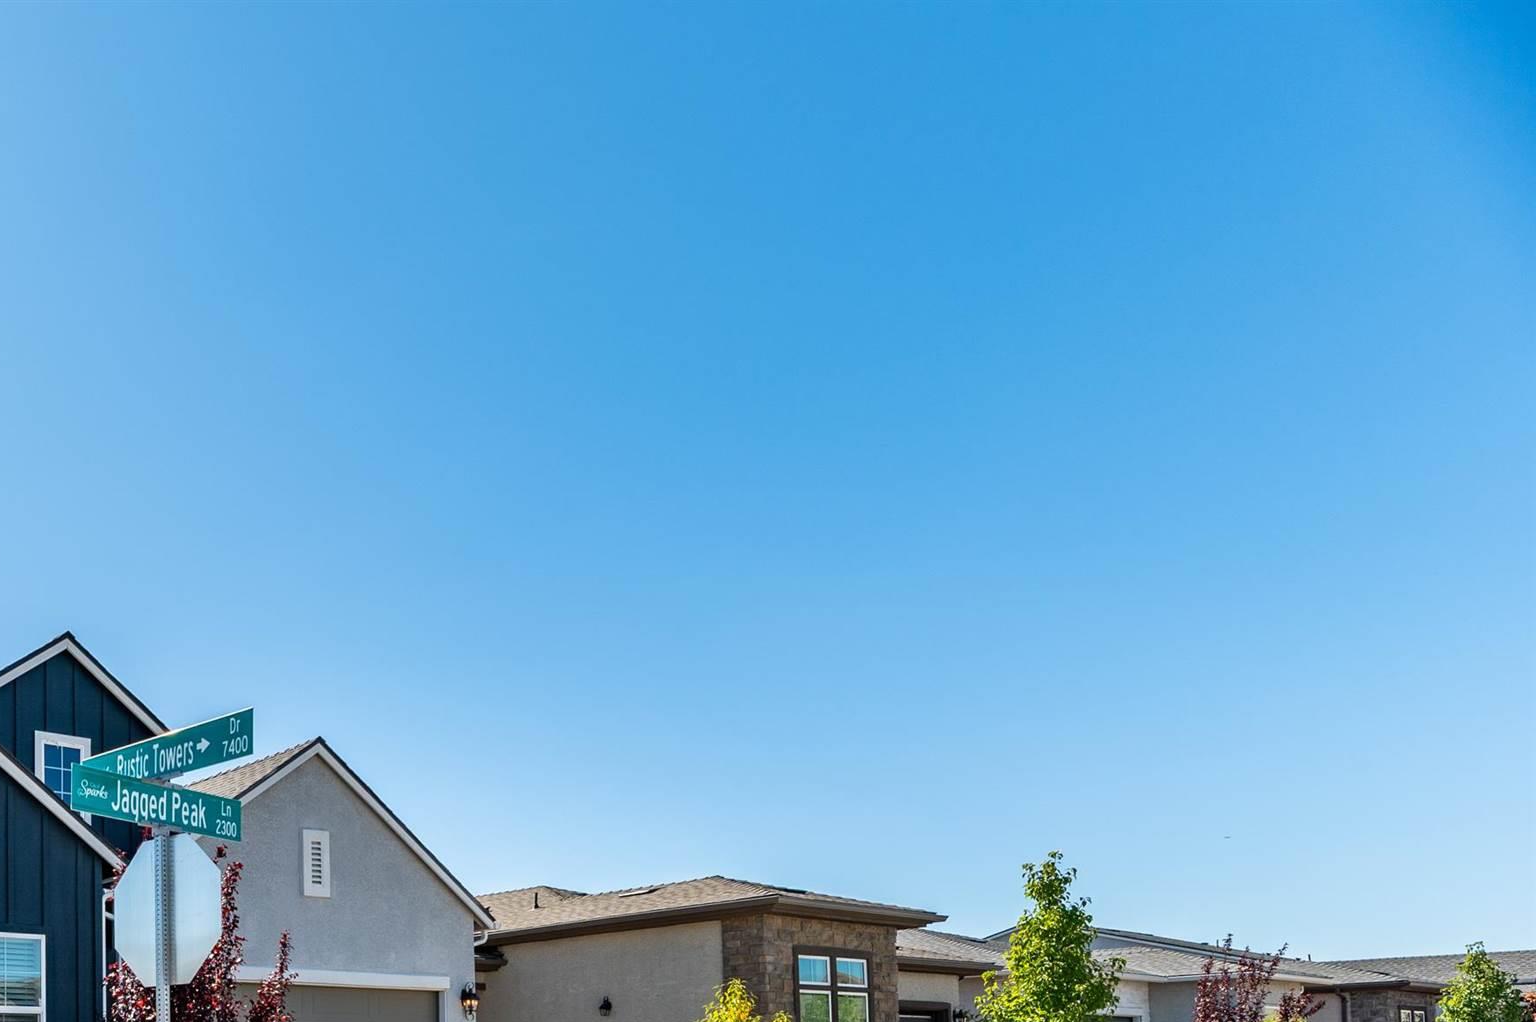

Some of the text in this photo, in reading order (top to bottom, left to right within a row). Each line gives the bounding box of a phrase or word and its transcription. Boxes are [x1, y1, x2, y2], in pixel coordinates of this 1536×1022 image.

[229, 717, 241, 735] Dr
[222, 735, 248, 757] 7400
[116, 740, 195, 779] Rustic Towers
[78, 778, 108, 800] Sparks
[111, 780, 208, 829] Jagged Peak
[221, 800, 232, 818] Ln
[215, 821, 237, 838] 2300
